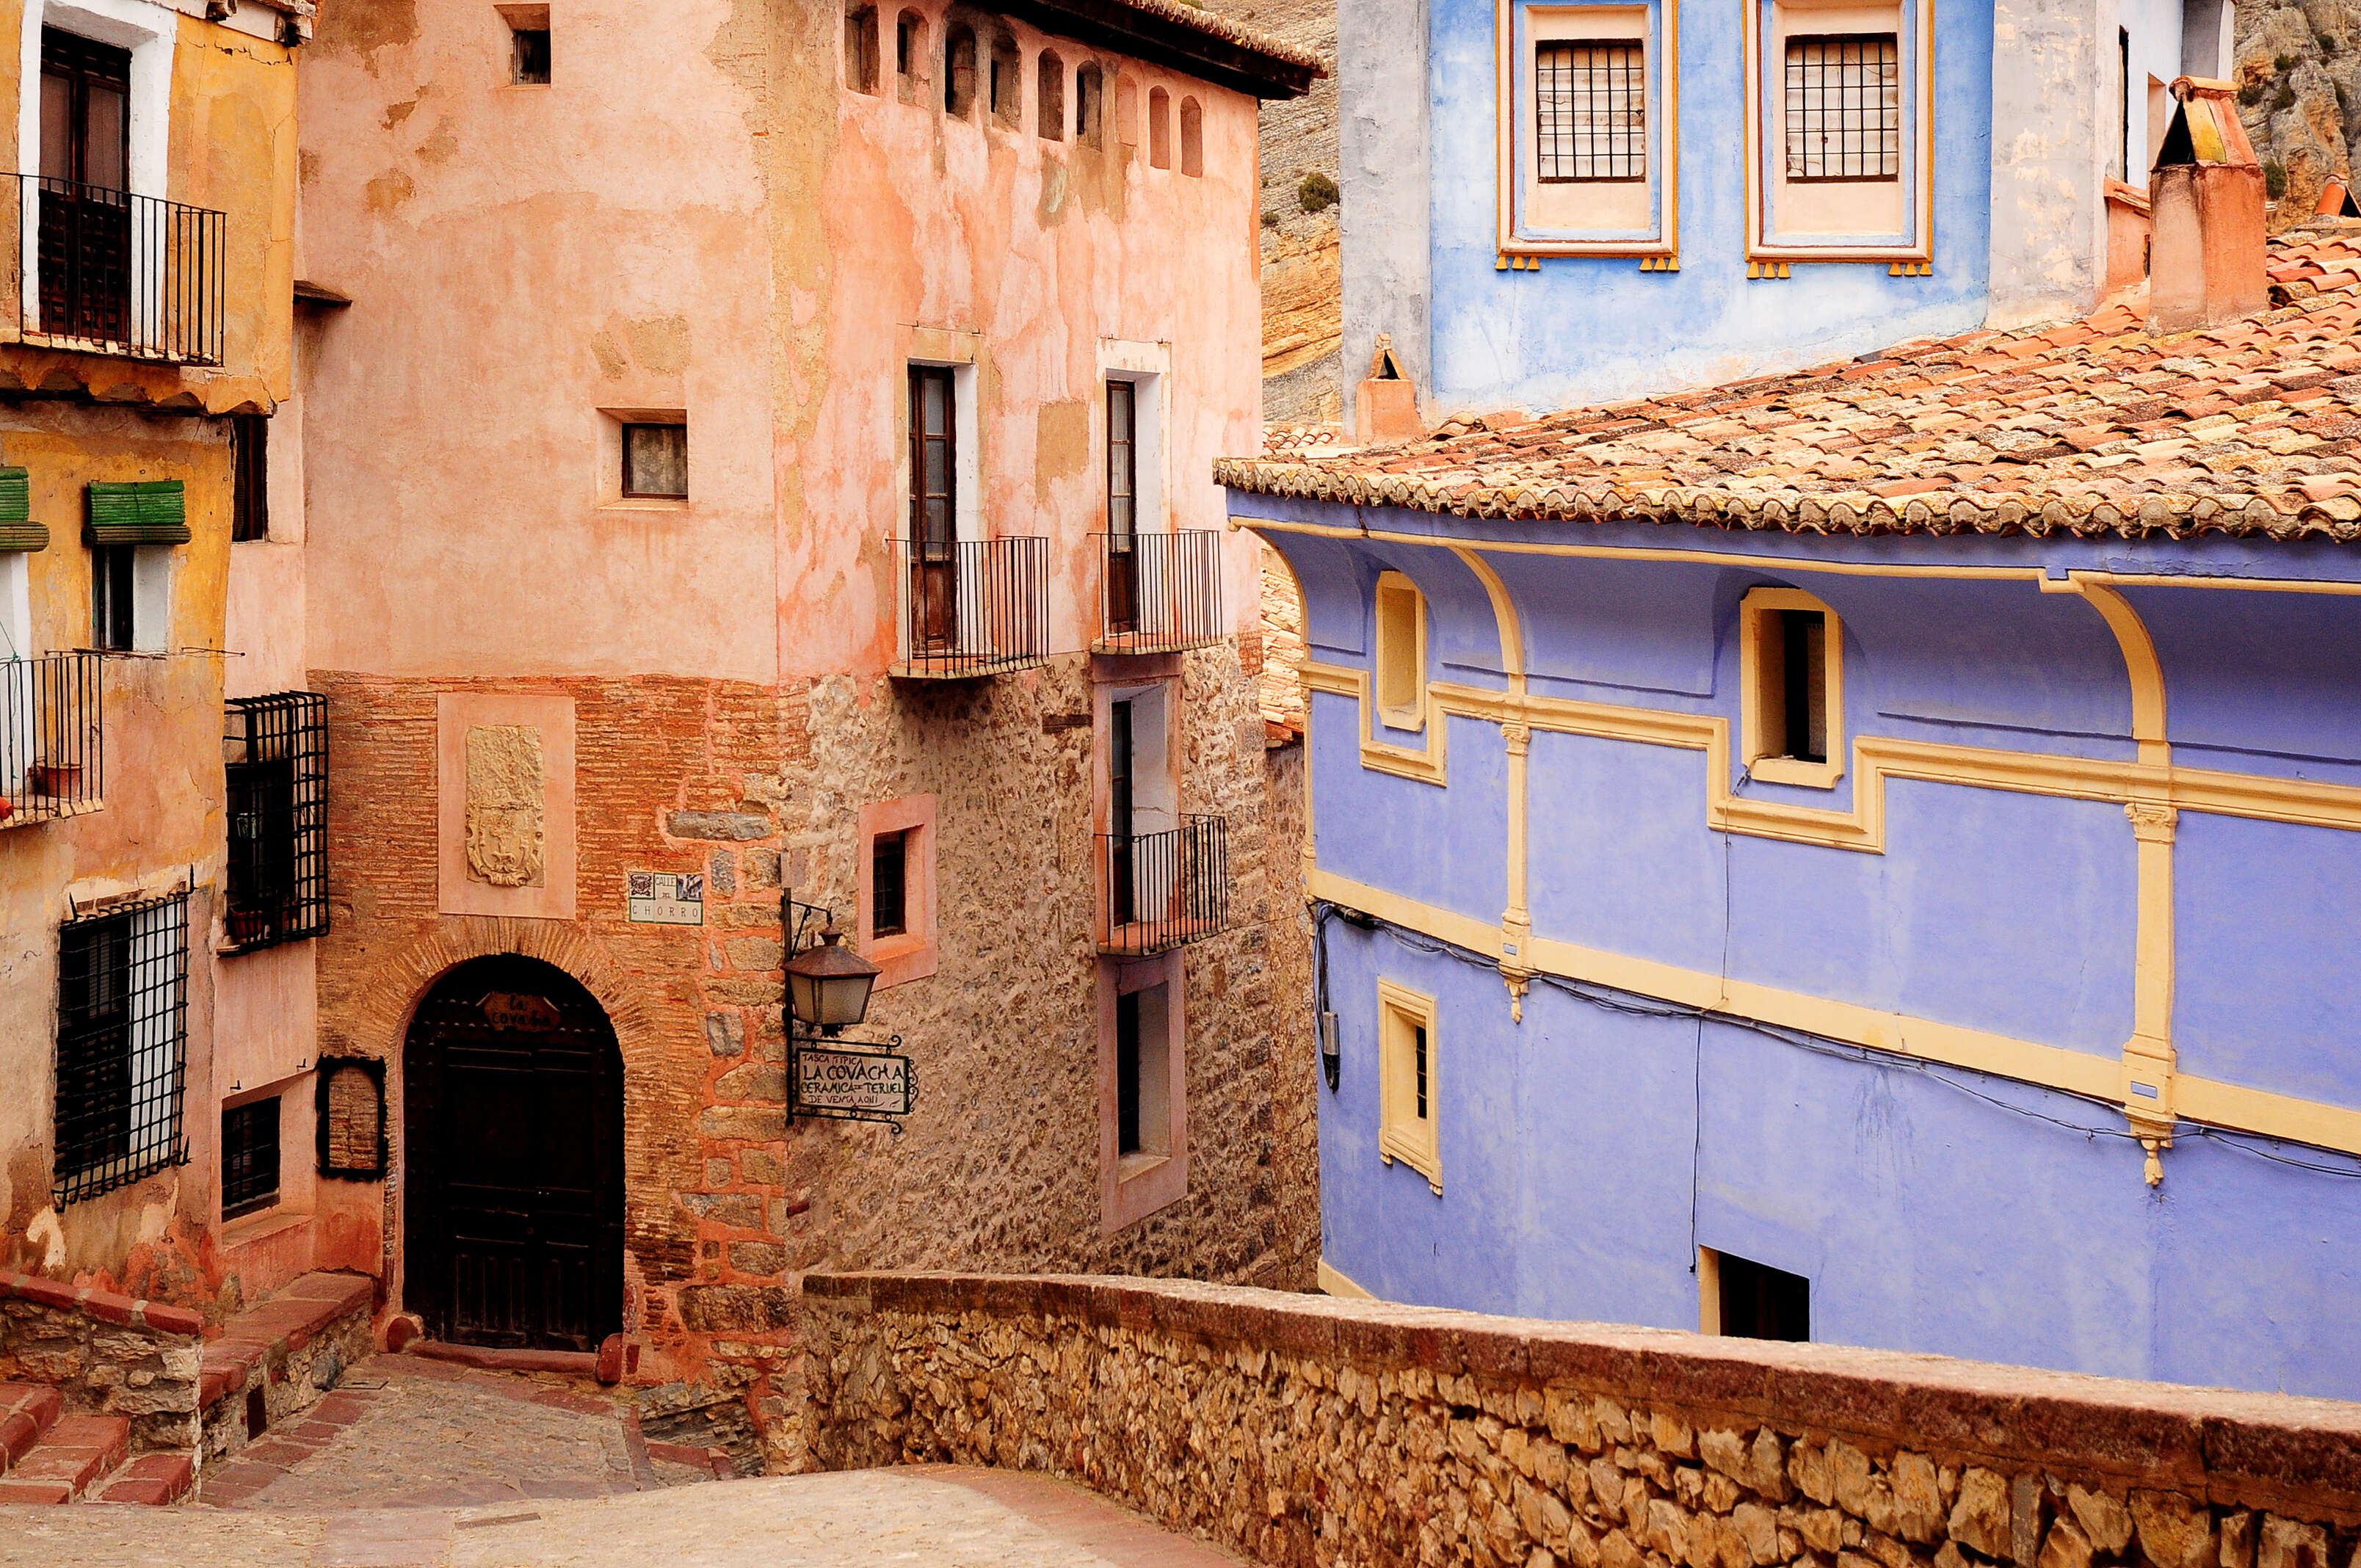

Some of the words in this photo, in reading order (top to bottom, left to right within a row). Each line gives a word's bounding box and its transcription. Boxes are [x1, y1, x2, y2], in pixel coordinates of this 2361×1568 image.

[656, 876, 675, 887] CALLE
[632, 905, 698, 918] CHORRO
[802, 1053, 830, 1064] TASCA
[803, 1065, 824, 1081] LA
[826, 1062, 904, 1081] COVACHA
[800, 1081, 855, 1093] CERAMICA
[863, 1082, 905, 1094] TERUEL
[808, 1095, 823, 1103] DE
[826, 1095, 855, 1103] VENTA
